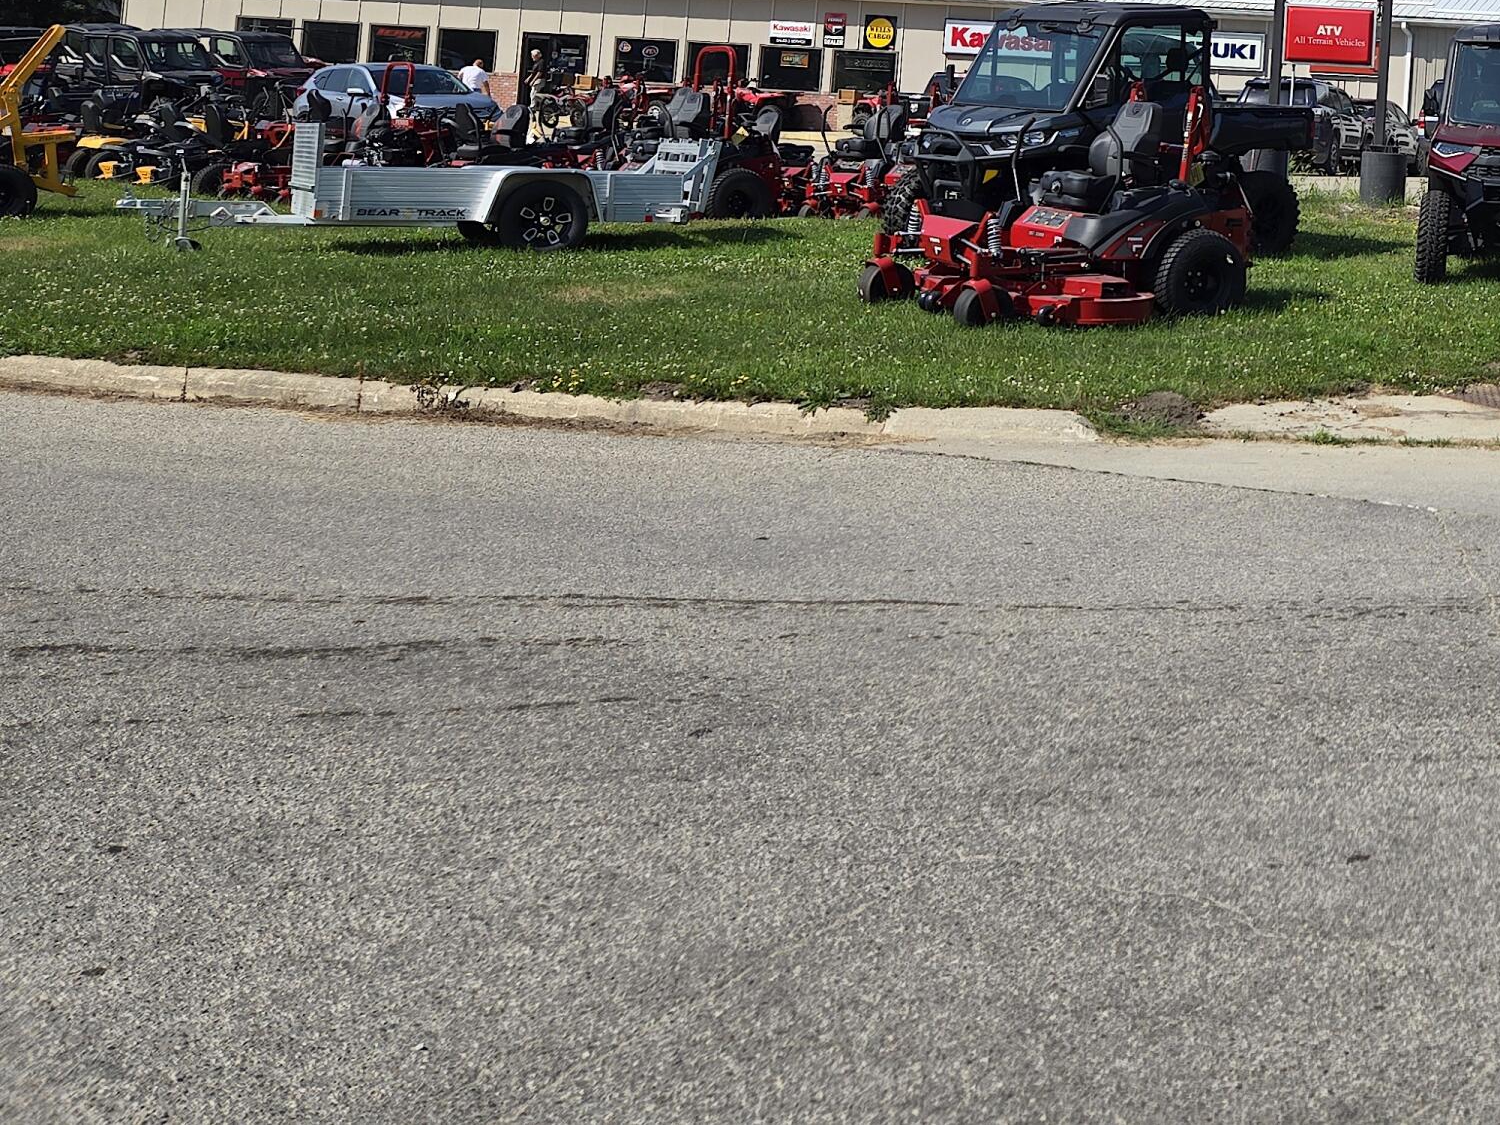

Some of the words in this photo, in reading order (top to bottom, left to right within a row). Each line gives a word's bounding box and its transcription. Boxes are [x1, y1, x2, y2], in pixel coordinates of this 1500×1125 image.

[773, 23, 812, 33] Kawasaki
[1316, 24, 1343, 36] ATV
[951, 26, 1057, 52] Kawasa
[1293, 35, 1306, 44] All
[1307, 36, 1333, 46] Terrain
[1335, 37, 1366, 47] Vehicles
[356, 208, 400, 216] BEAR
[417, 208, 467, 217] TRACK
